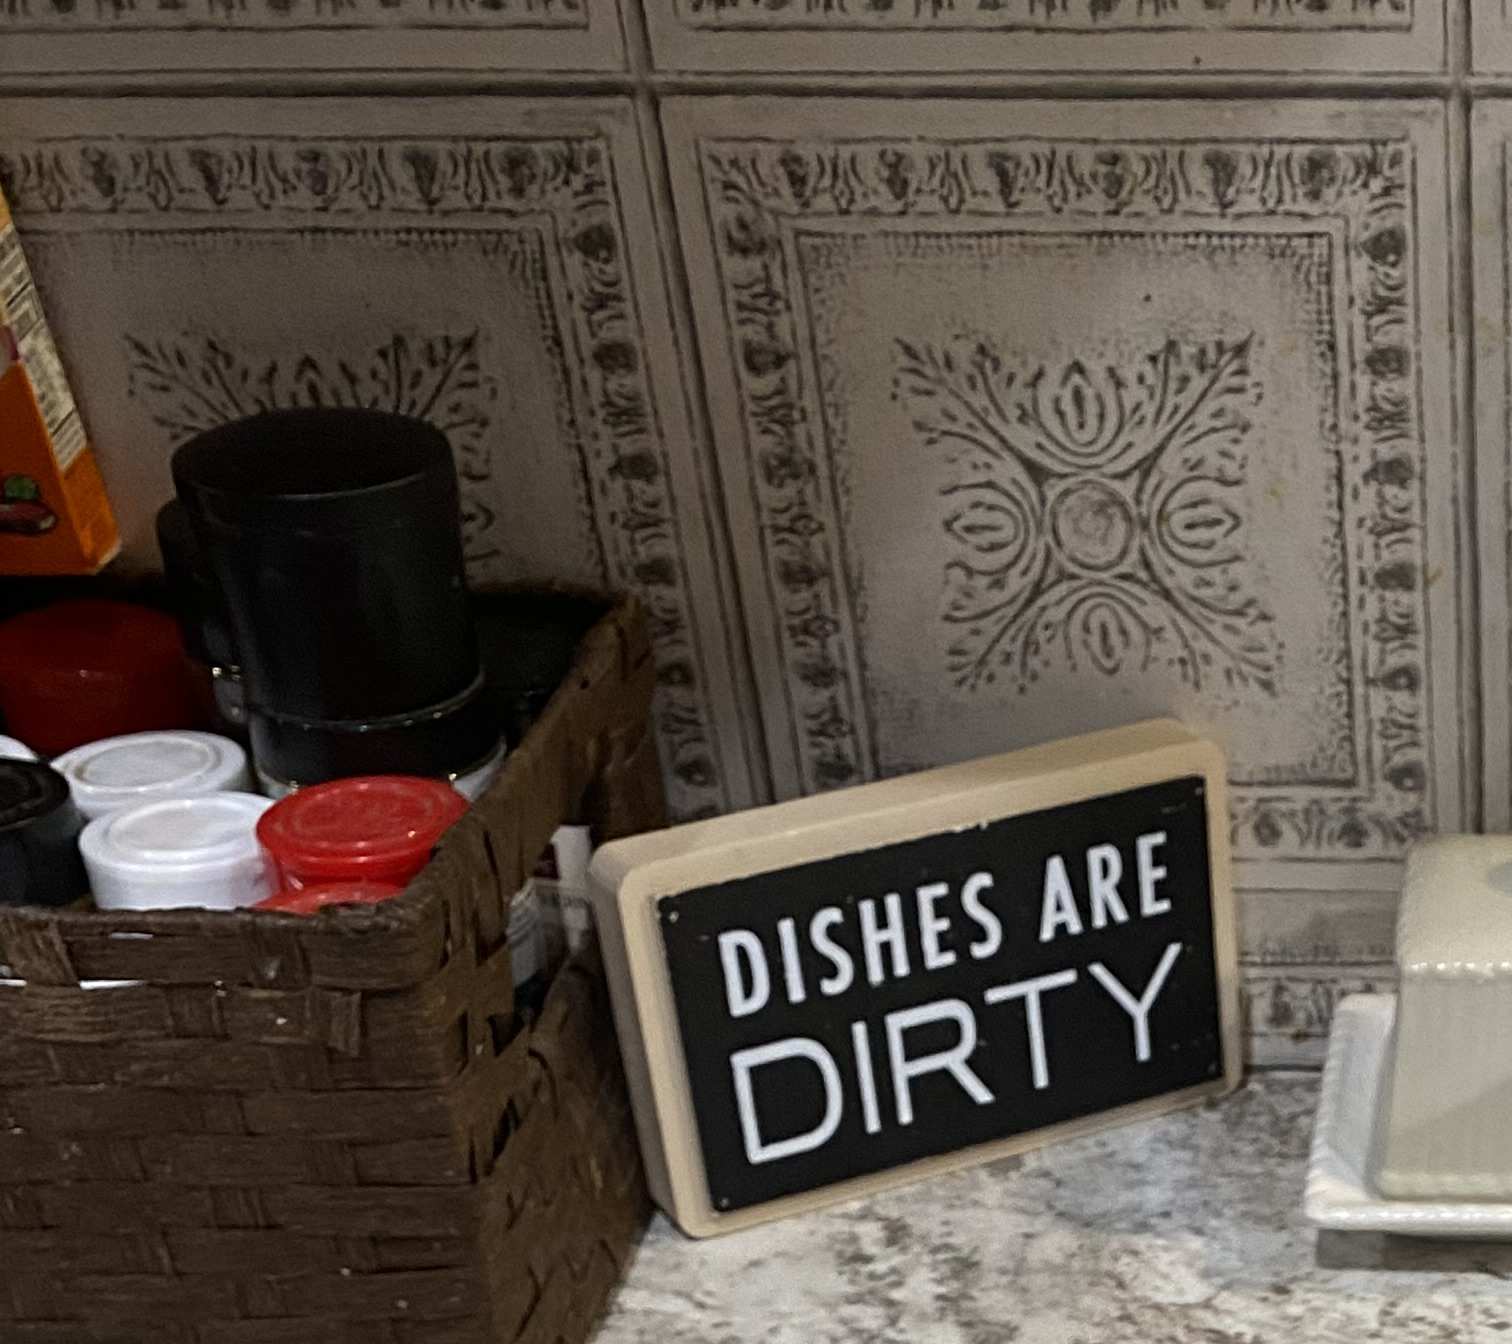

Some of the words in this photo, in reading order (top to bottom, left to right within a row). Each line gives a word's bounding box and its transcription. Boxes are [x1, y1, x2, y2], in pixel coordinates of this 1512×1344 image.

[717, 870, 1003, 1019] DISHES
[1038, 831, 1173, 943] ARE
[729, 942, 1184, 1165] DIRTY
